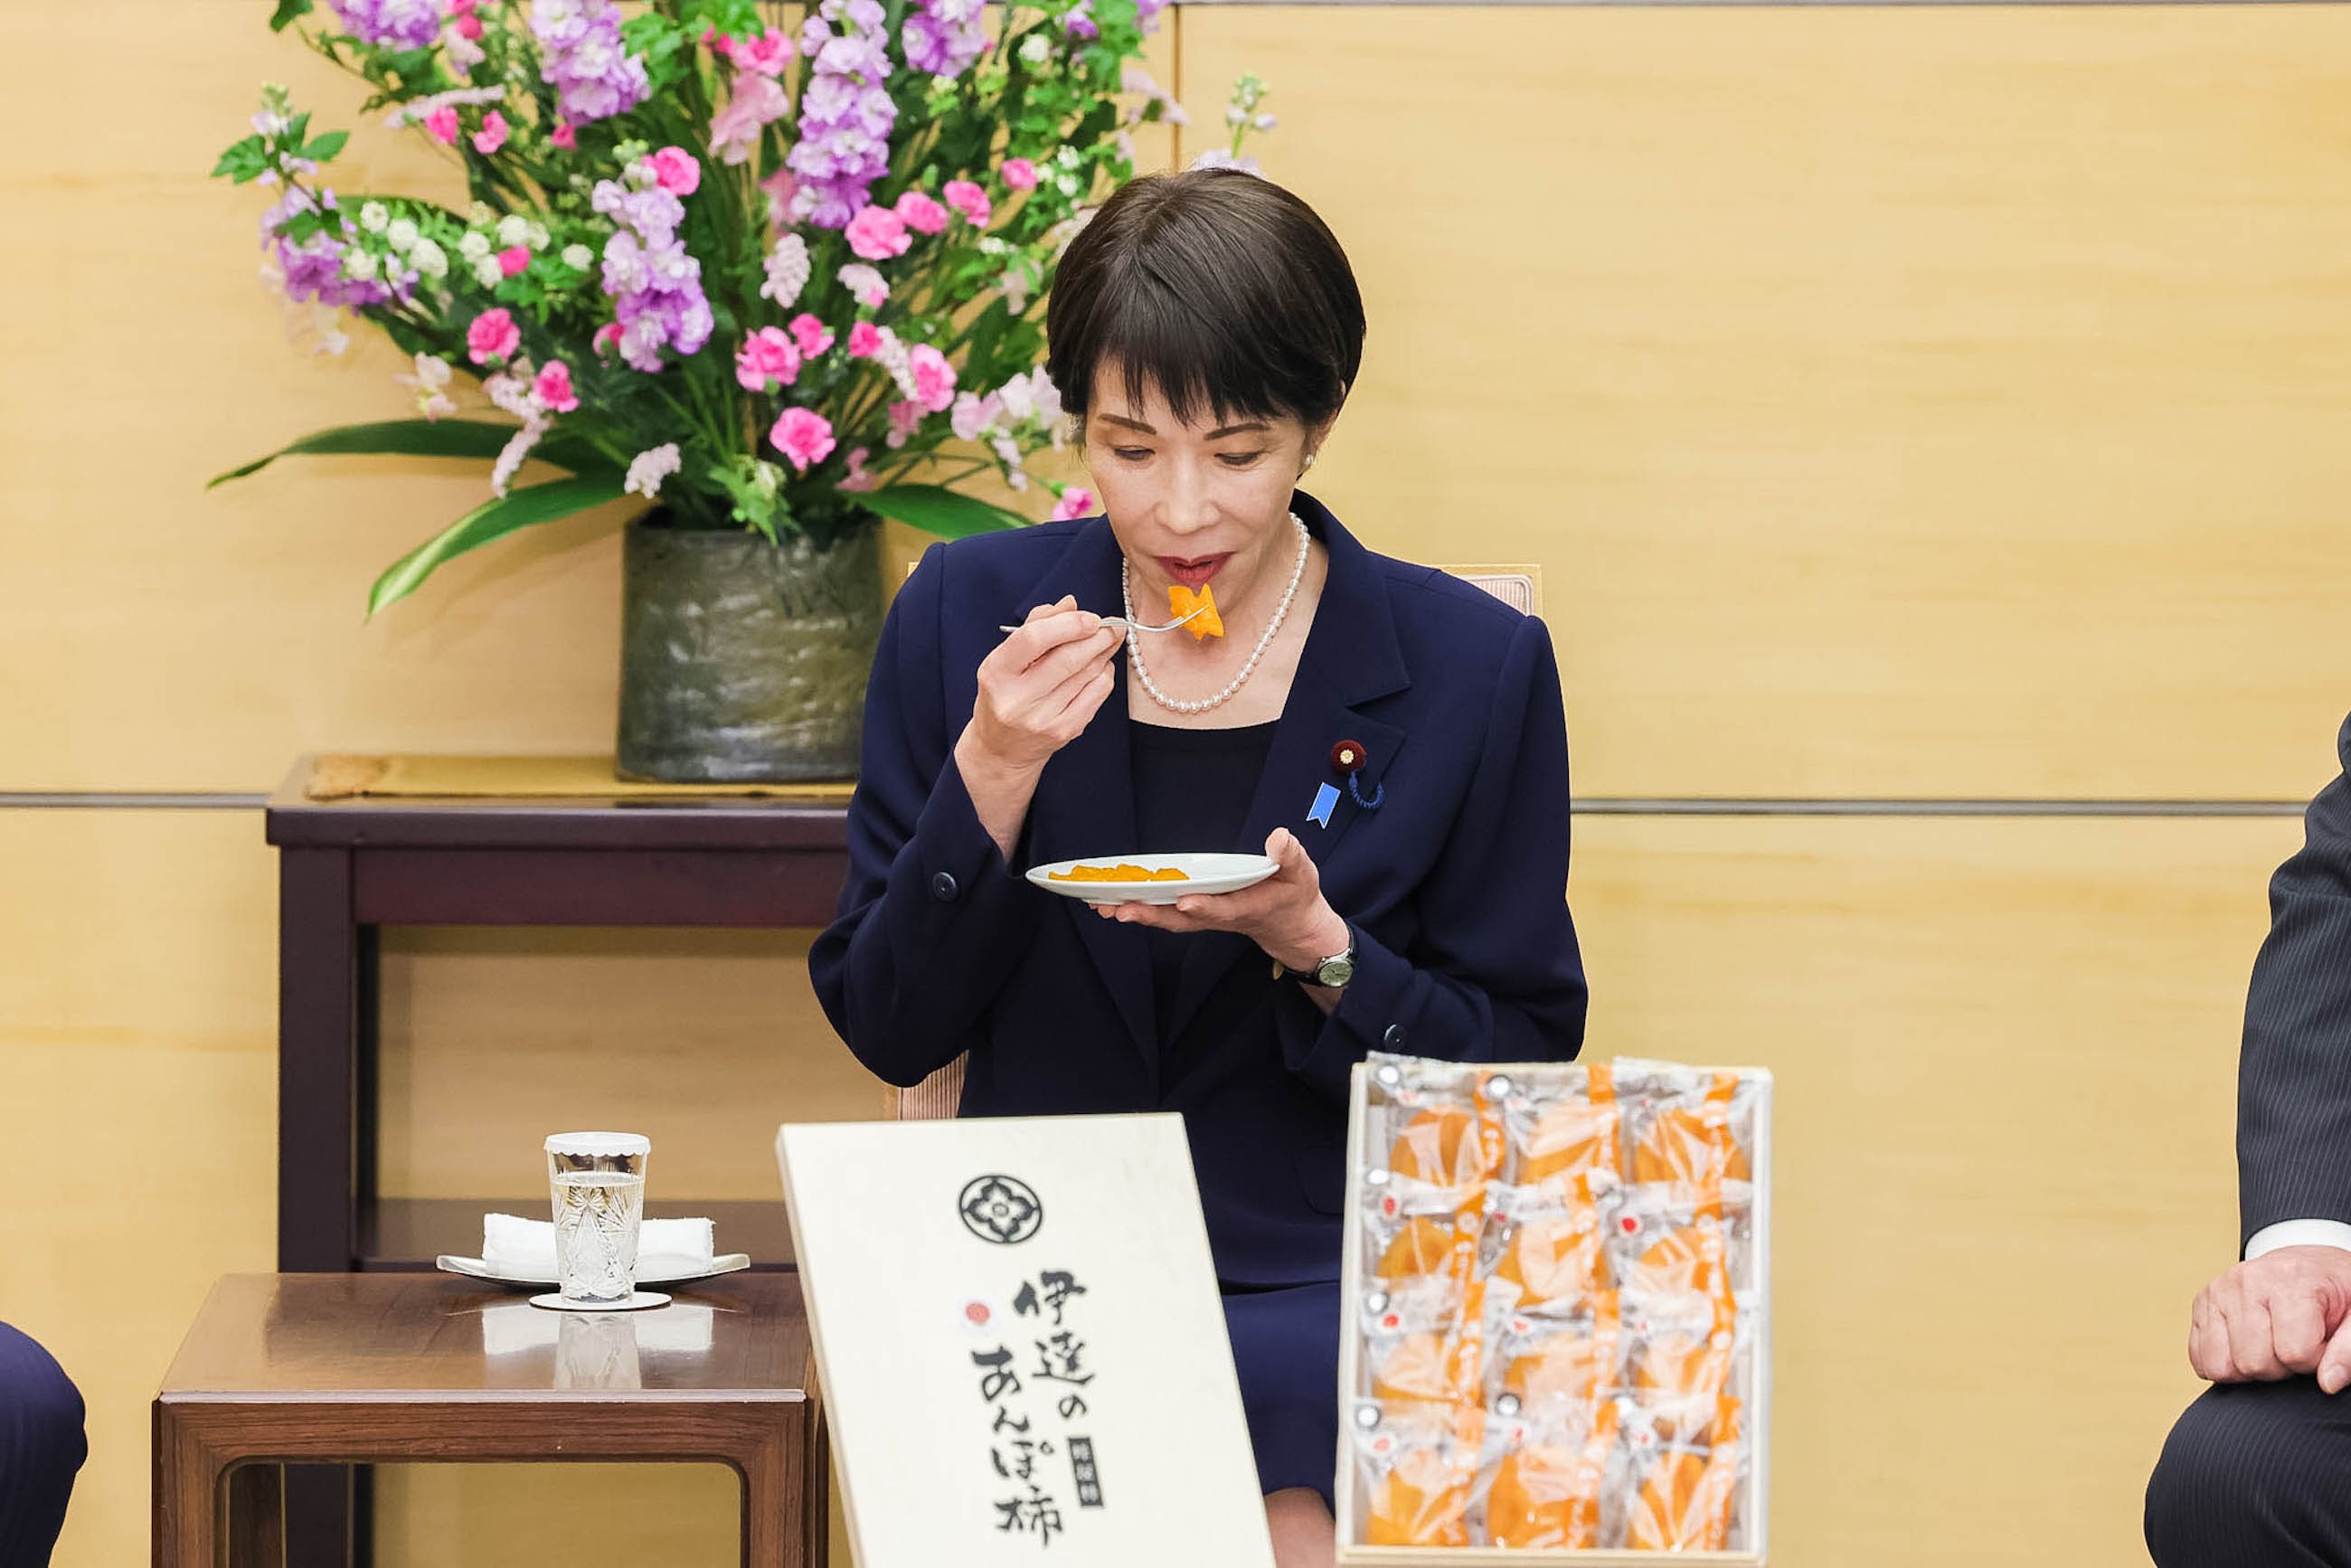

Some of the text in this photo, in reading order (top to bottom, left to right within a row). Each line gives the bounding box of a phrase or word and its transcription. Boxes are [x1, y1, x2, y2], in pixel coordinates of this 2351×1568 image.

[1013, 1270, 1095, 1420] 伊達の
[971, 1345, 1064, 1547] あんぽ柿
